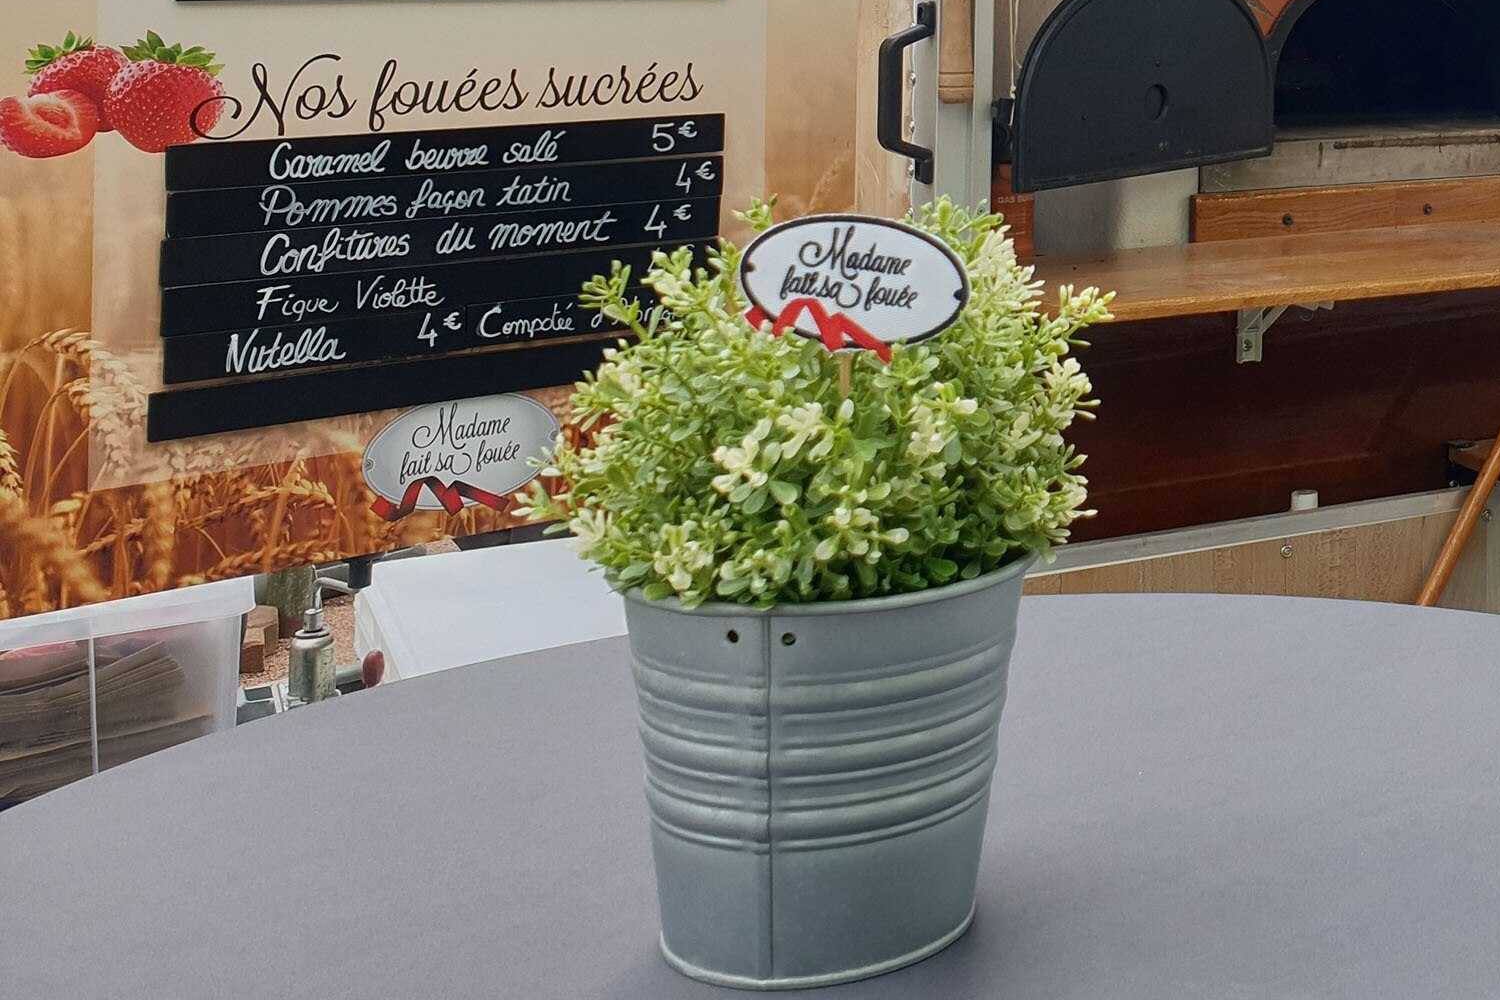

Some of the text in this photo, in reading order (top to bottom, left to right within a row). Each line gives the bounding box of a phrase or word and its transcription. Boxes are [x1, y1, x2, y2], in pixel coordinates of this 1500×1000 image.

[189, 53, 704, 140] Nos fouées sucrées
[268, 139, 392, 180] Caramel
[404, 138, 490, 171] beurre
[502, 130, 567, 165] salé
[258, 184, 398, 226] Pommes
[404, 178, 486, 219] façon
[496, 175, 572, 206] tatin
[259, 227, 411, 276] Confitures
[435, 221, 476, 255] du
[487, 211, 618, 251] moment
[798, 225, 912, 281] Madame
[356, 275, 445, 310] Violette
[779, 264, 919, 312] fait sa fouée
[476, 302, 576, 338] Compotée
[225, 326, 347, 374] Nutella
[411, 402, 511, 450] Madame
[399, 439, 521, 485] fait sa fouée
